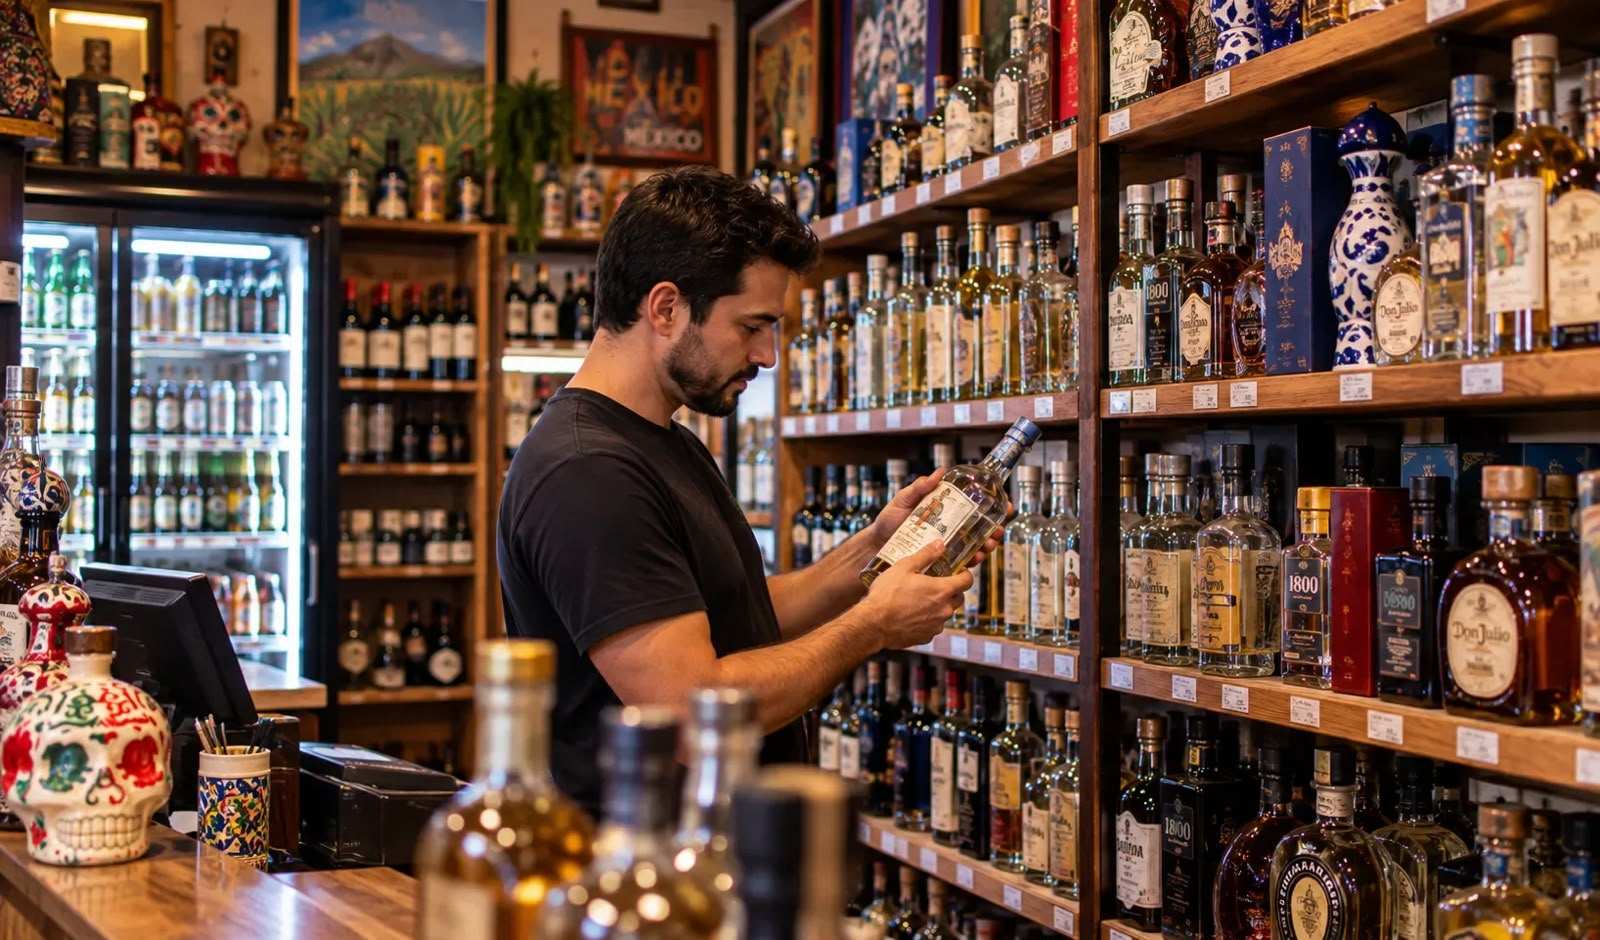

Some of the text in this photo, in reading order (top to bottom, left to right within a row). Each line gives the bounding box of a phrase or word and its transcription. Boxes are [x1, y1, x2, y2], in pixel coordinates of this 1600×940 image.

[1146, 281, 1169, 299] 1800
[1289, 575, 1319, 594] 1800
[1452, 621, 1511, 646] Don Julio
[1165, 817, 1191, 841] 1800
